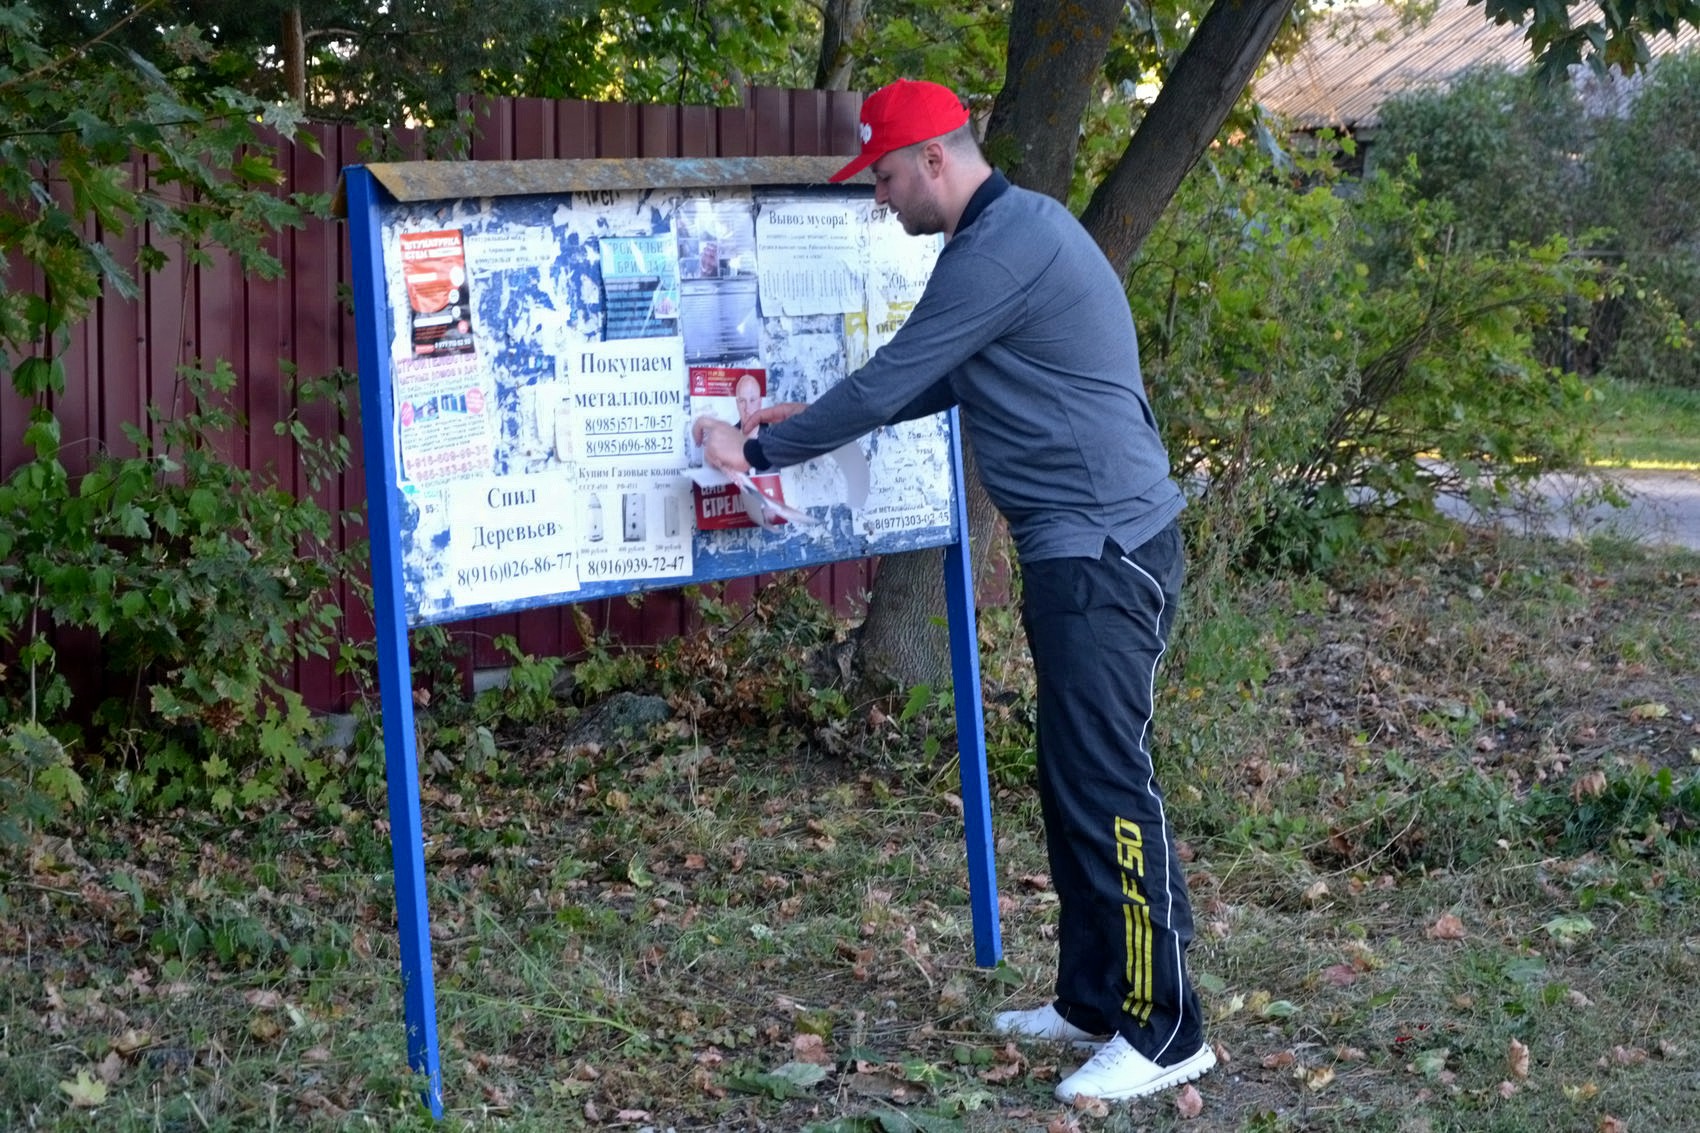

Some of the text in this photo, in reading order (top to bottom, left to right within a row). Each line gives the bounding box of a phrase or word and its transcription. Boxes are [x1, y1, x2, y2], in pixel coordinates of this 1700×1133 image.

[769, 211, 848, 229] Вывоз мусора!
[580, 352, 672, 379] Покупаем
[574, 388, 680, 409] металлолом
[585, 415, 673, 433] 8(985)571-70-57
[585, 436, 673, 455] 8(985)696-88-22
[579, 467, 609, 481] Купим
[611, 466, 648, 479] Газовые
[487, 486, 536, 510] Спил
[472, 520, 556, 552] Деревьев
[457, 552, 573, 588] 8(916)026-86-77
[588, 556, 685, 577] 8(916)939-72-47
